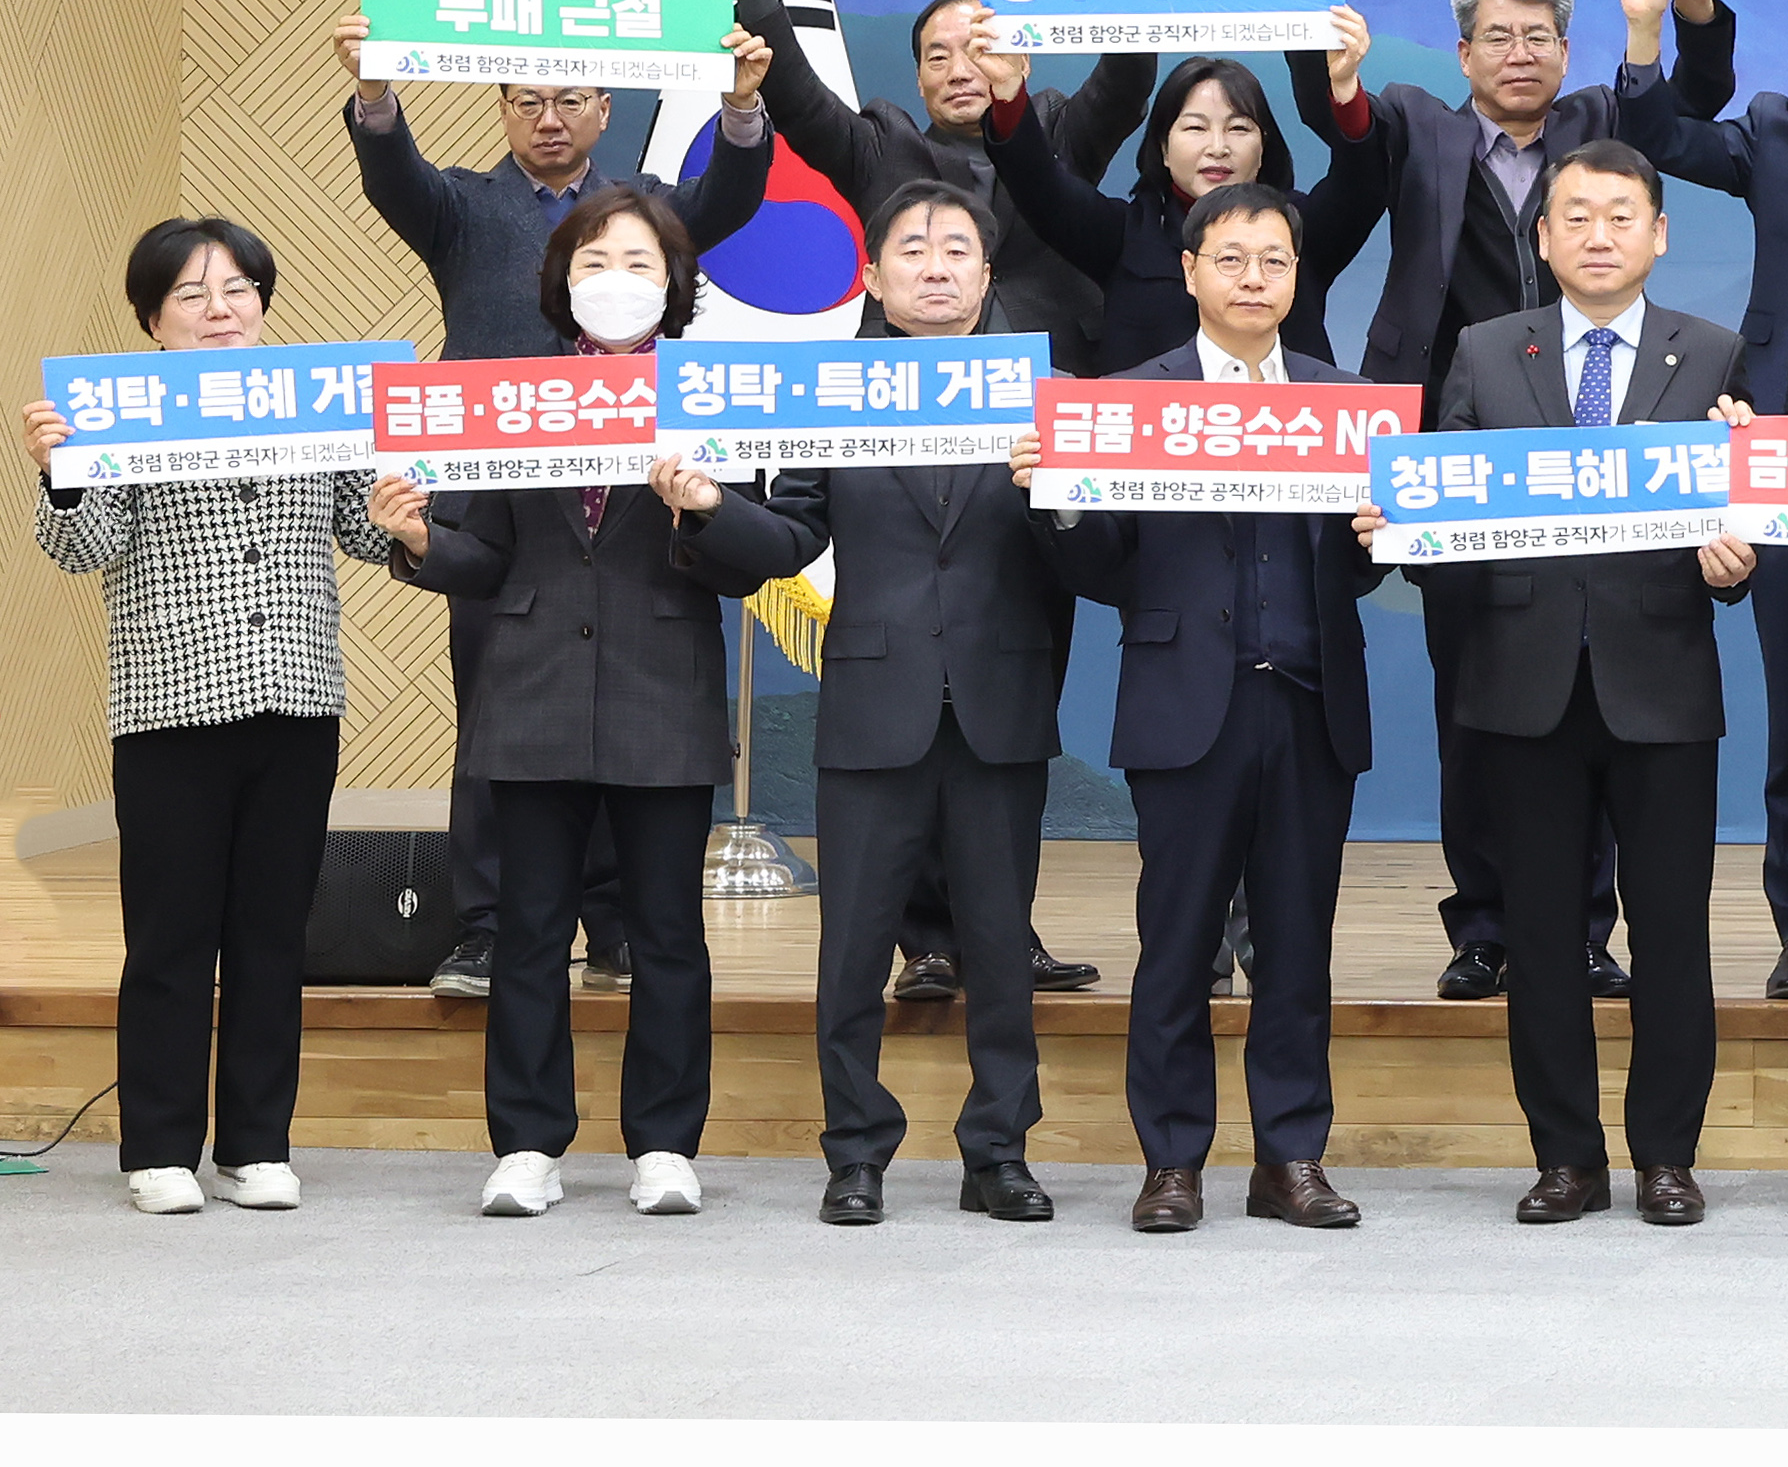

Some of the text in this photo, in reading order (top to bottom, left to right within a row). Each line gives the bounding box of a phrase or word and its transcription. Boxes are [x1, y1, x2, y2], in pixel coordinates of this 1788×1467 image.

[1049, 24, 1084, 44] 청렴
[1088, 24, 1142, 44] 함양군
[1146, 24, 1215, 43] 공직자가
[436, 54, 472, 73] 청렴
[476, 55, 530, 75] 함양군
[534, 57, 604, 78] 공직자가
[936, 358, 1034, 410] 거절
[127, 445, 295, 474] 청렴 함양군 공직자가
[735, 437, 914, 459] 청렴 함양군 공직자가
[1108, 480, 1282, 502] 청렴 함양군 공직자가
[1449, 530, 1487, 551] 청렴
[1491, 527, 1548, 549] 함양군
[1552, 523, 1626, 547] 공직자가
